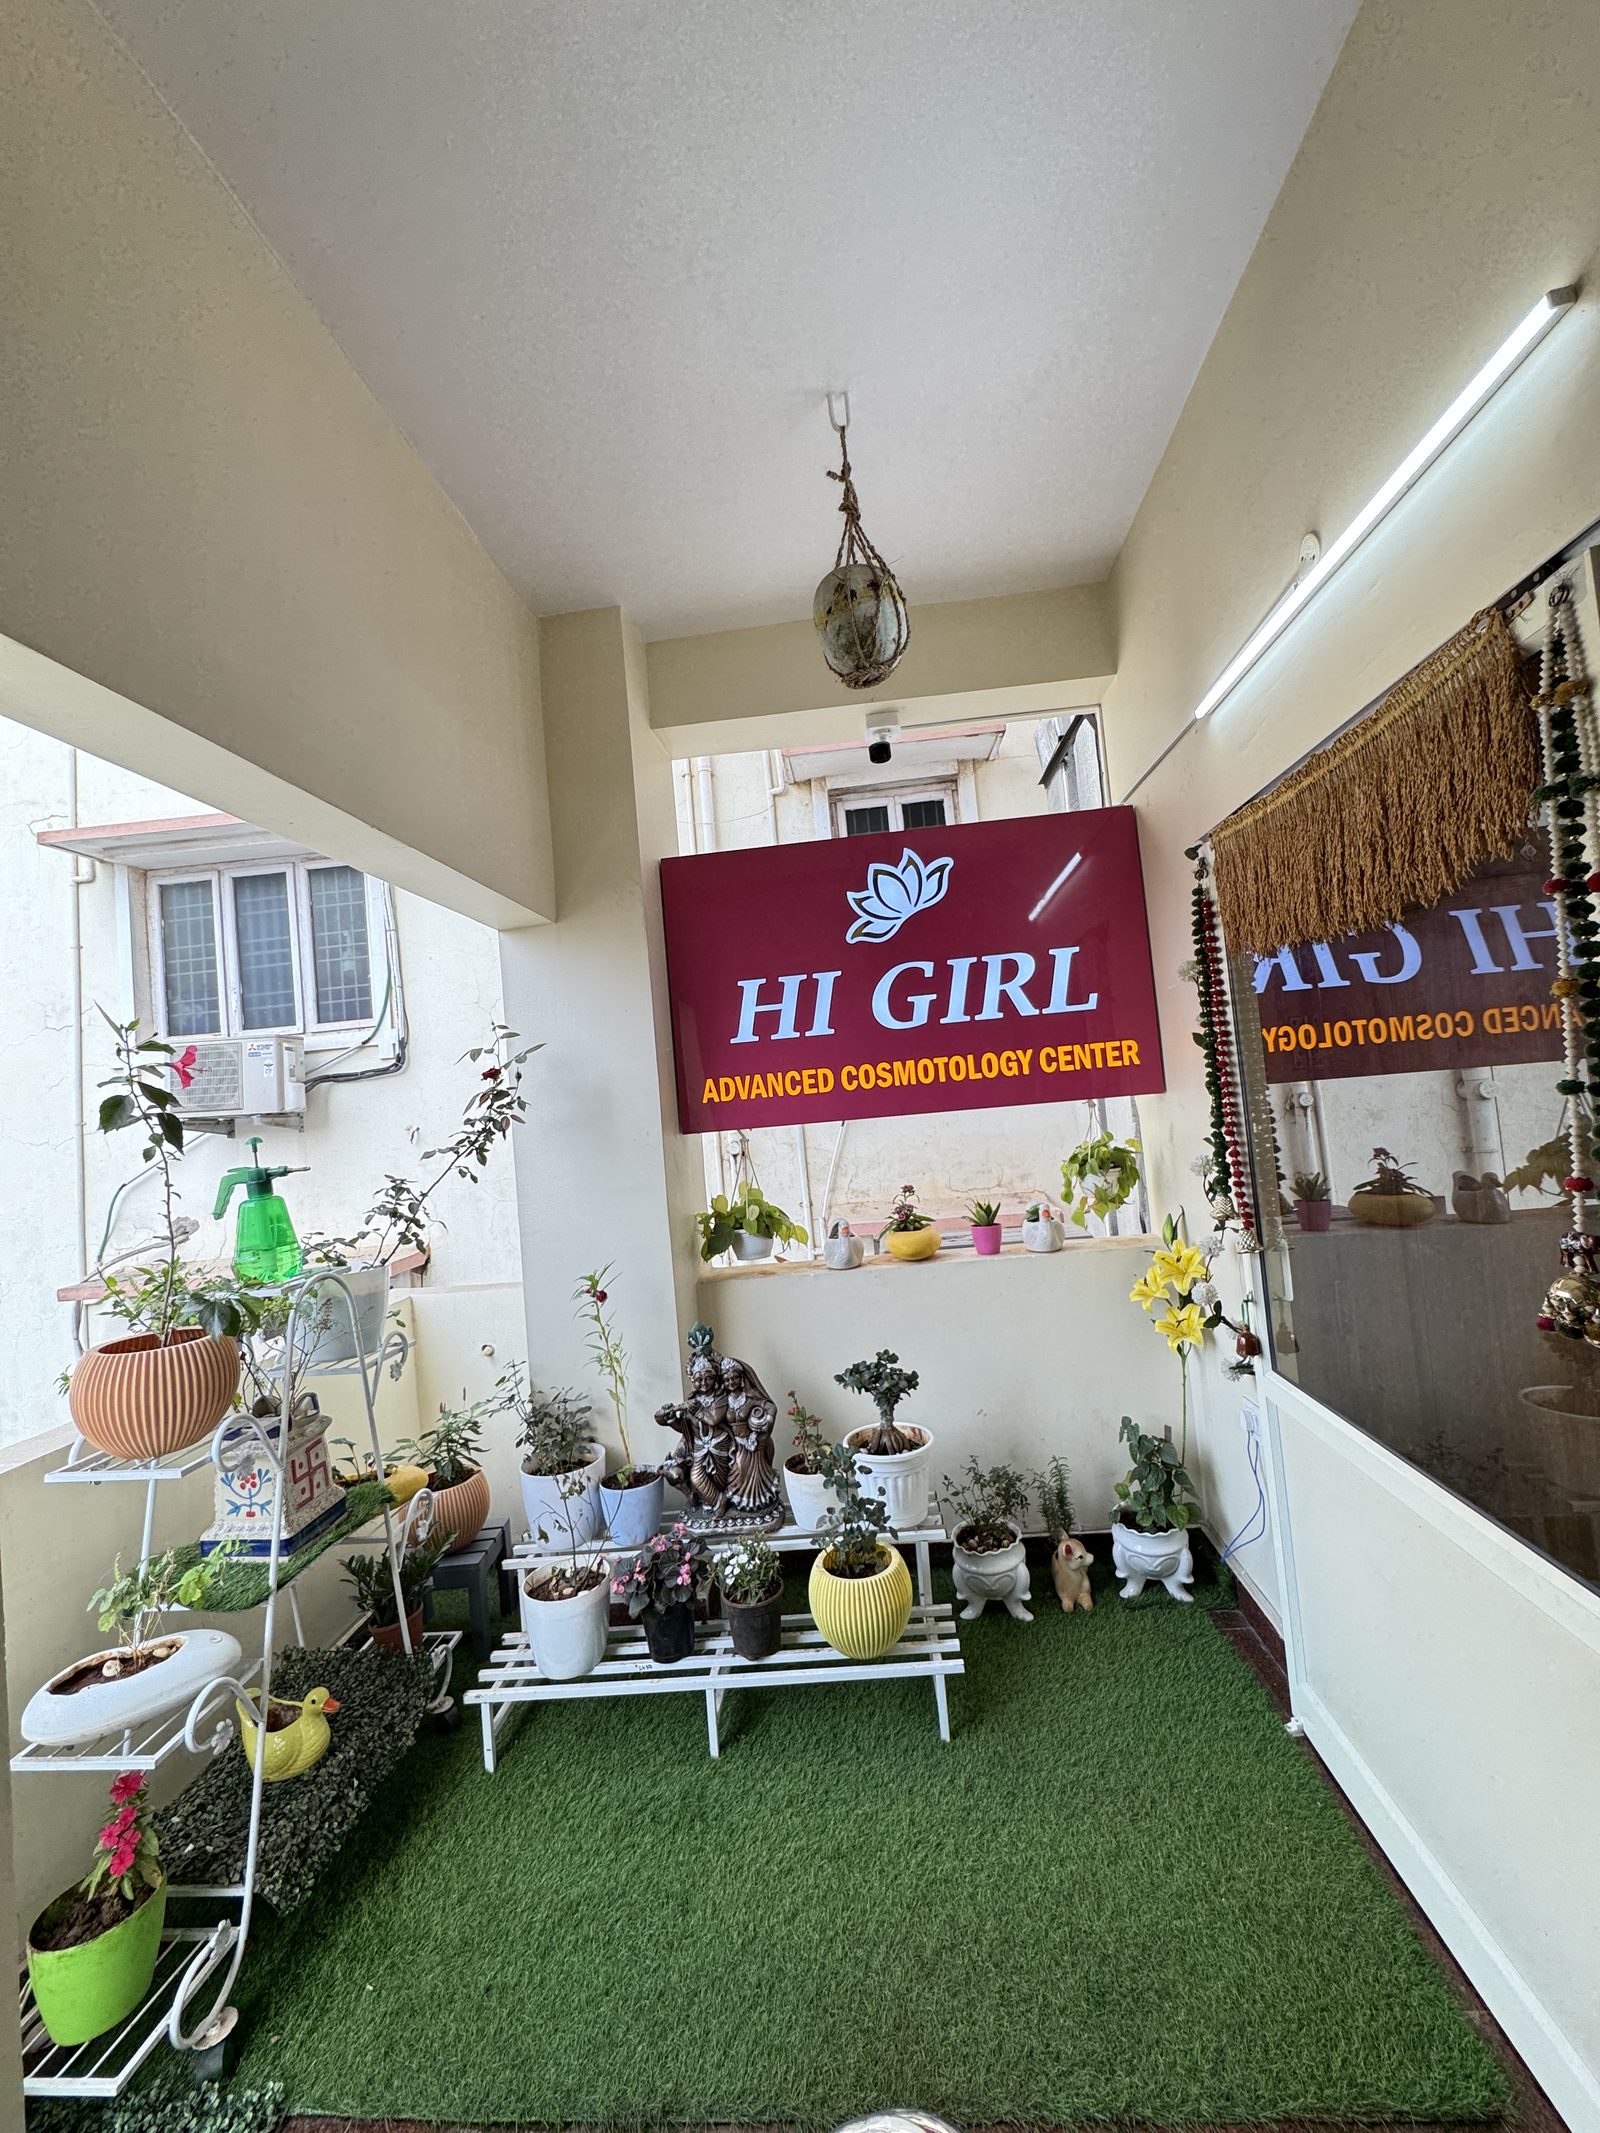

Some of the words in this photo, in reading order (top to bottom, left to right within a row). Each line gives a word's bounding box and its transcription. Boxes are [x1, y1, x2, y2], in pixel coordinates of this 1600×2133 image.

[729, 970, 842, 1044] HI
[871, 946, 1099, 1030] GIRL
[702, 1067, 835, 1104] ADVANCED
[840, 1049, 1033, 1091] COSMOTOLOGY
[1039, 1039, 1141, 1074] CENTER
